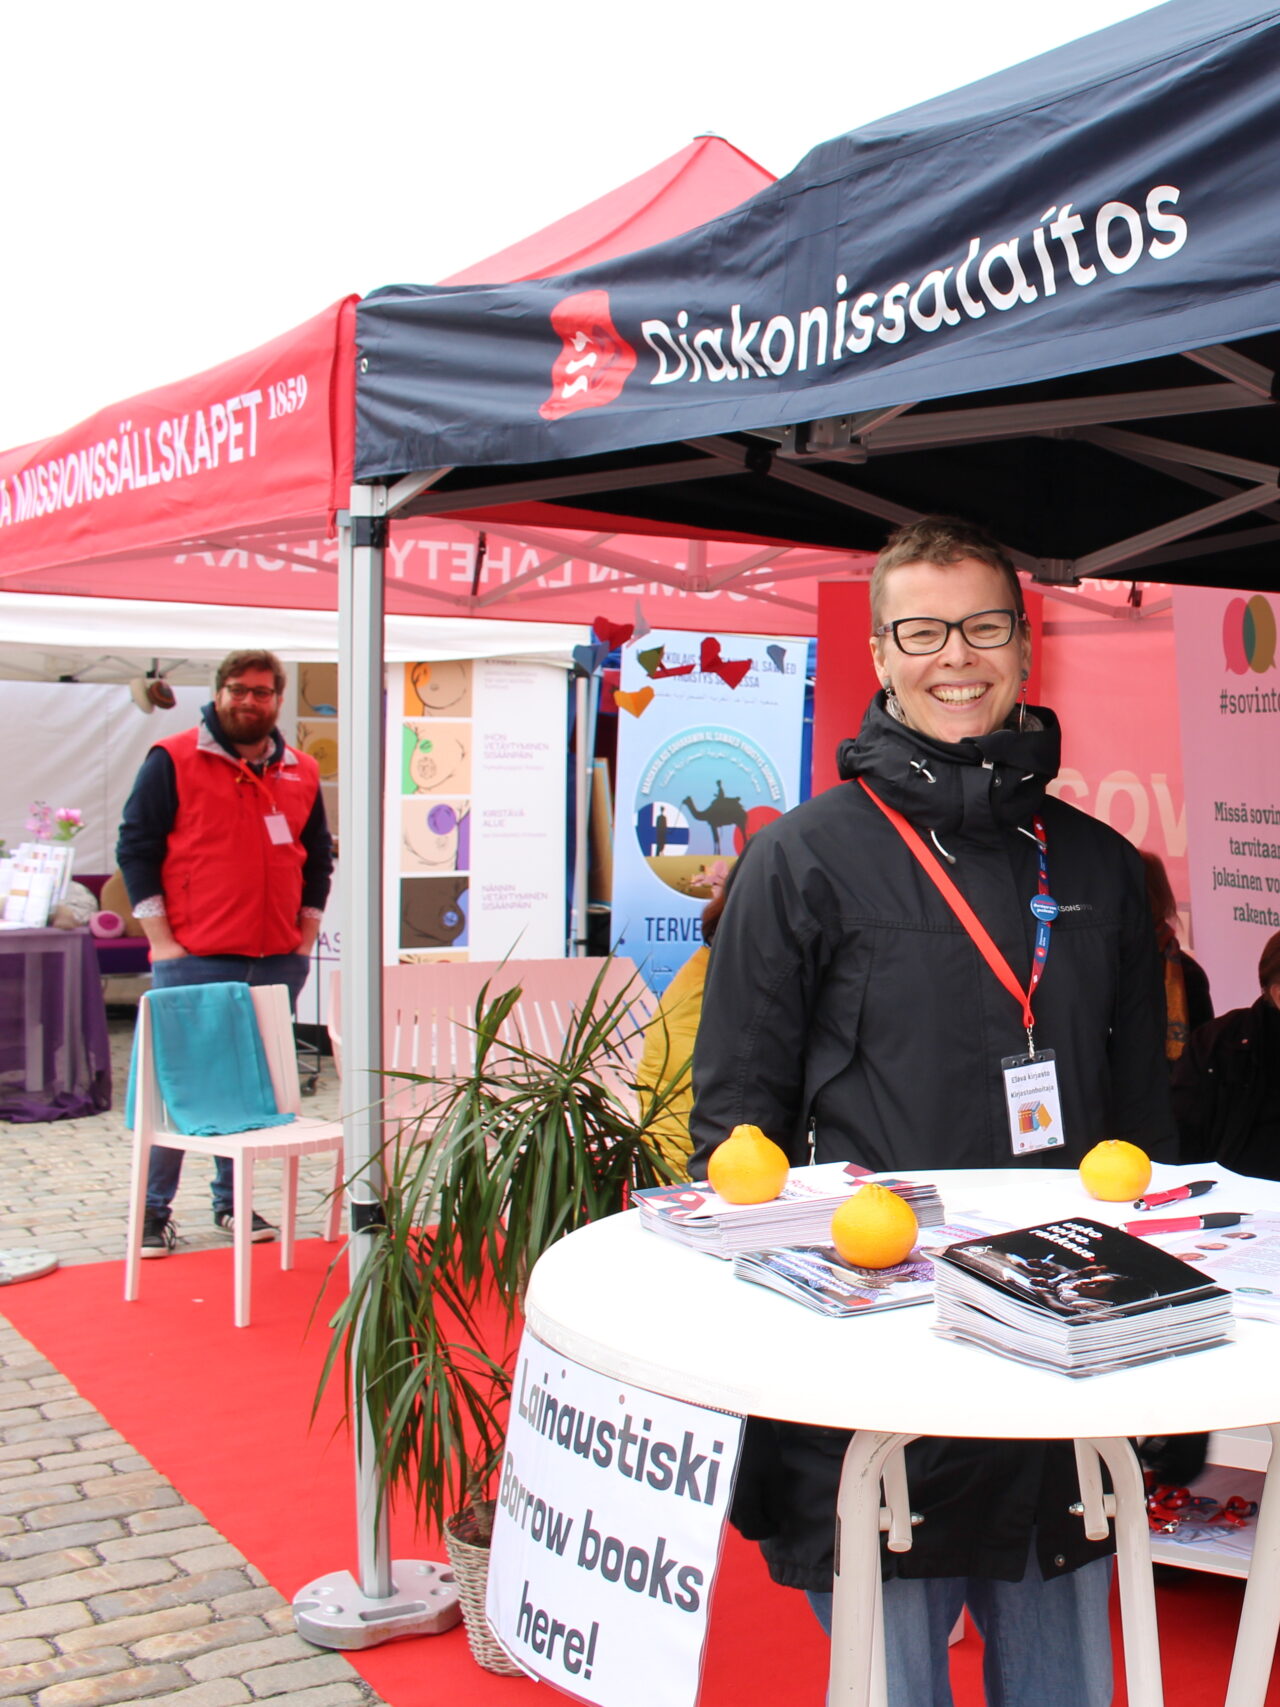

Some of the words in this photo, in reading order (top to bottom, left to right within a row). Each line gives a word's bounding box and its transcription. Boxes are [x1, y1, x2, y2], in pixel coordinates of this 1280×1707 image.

[641, 184, 1189, 386] Diakonissalaitos
[12, 389, 264, 524] MISSIONSSÄLLSKAPET
[267, 374, 308, 420] 1859
[1212, 866, 1263, 892] jokainen
[1214, 801, 1249, 823] Missä
[518, 1358, 724, 1506] Lainaustiski
[500, 1451, 574, 1557] Borrow
[577, 1508, 704, 1613] books
[516, 1579, 600, 1681] here!
